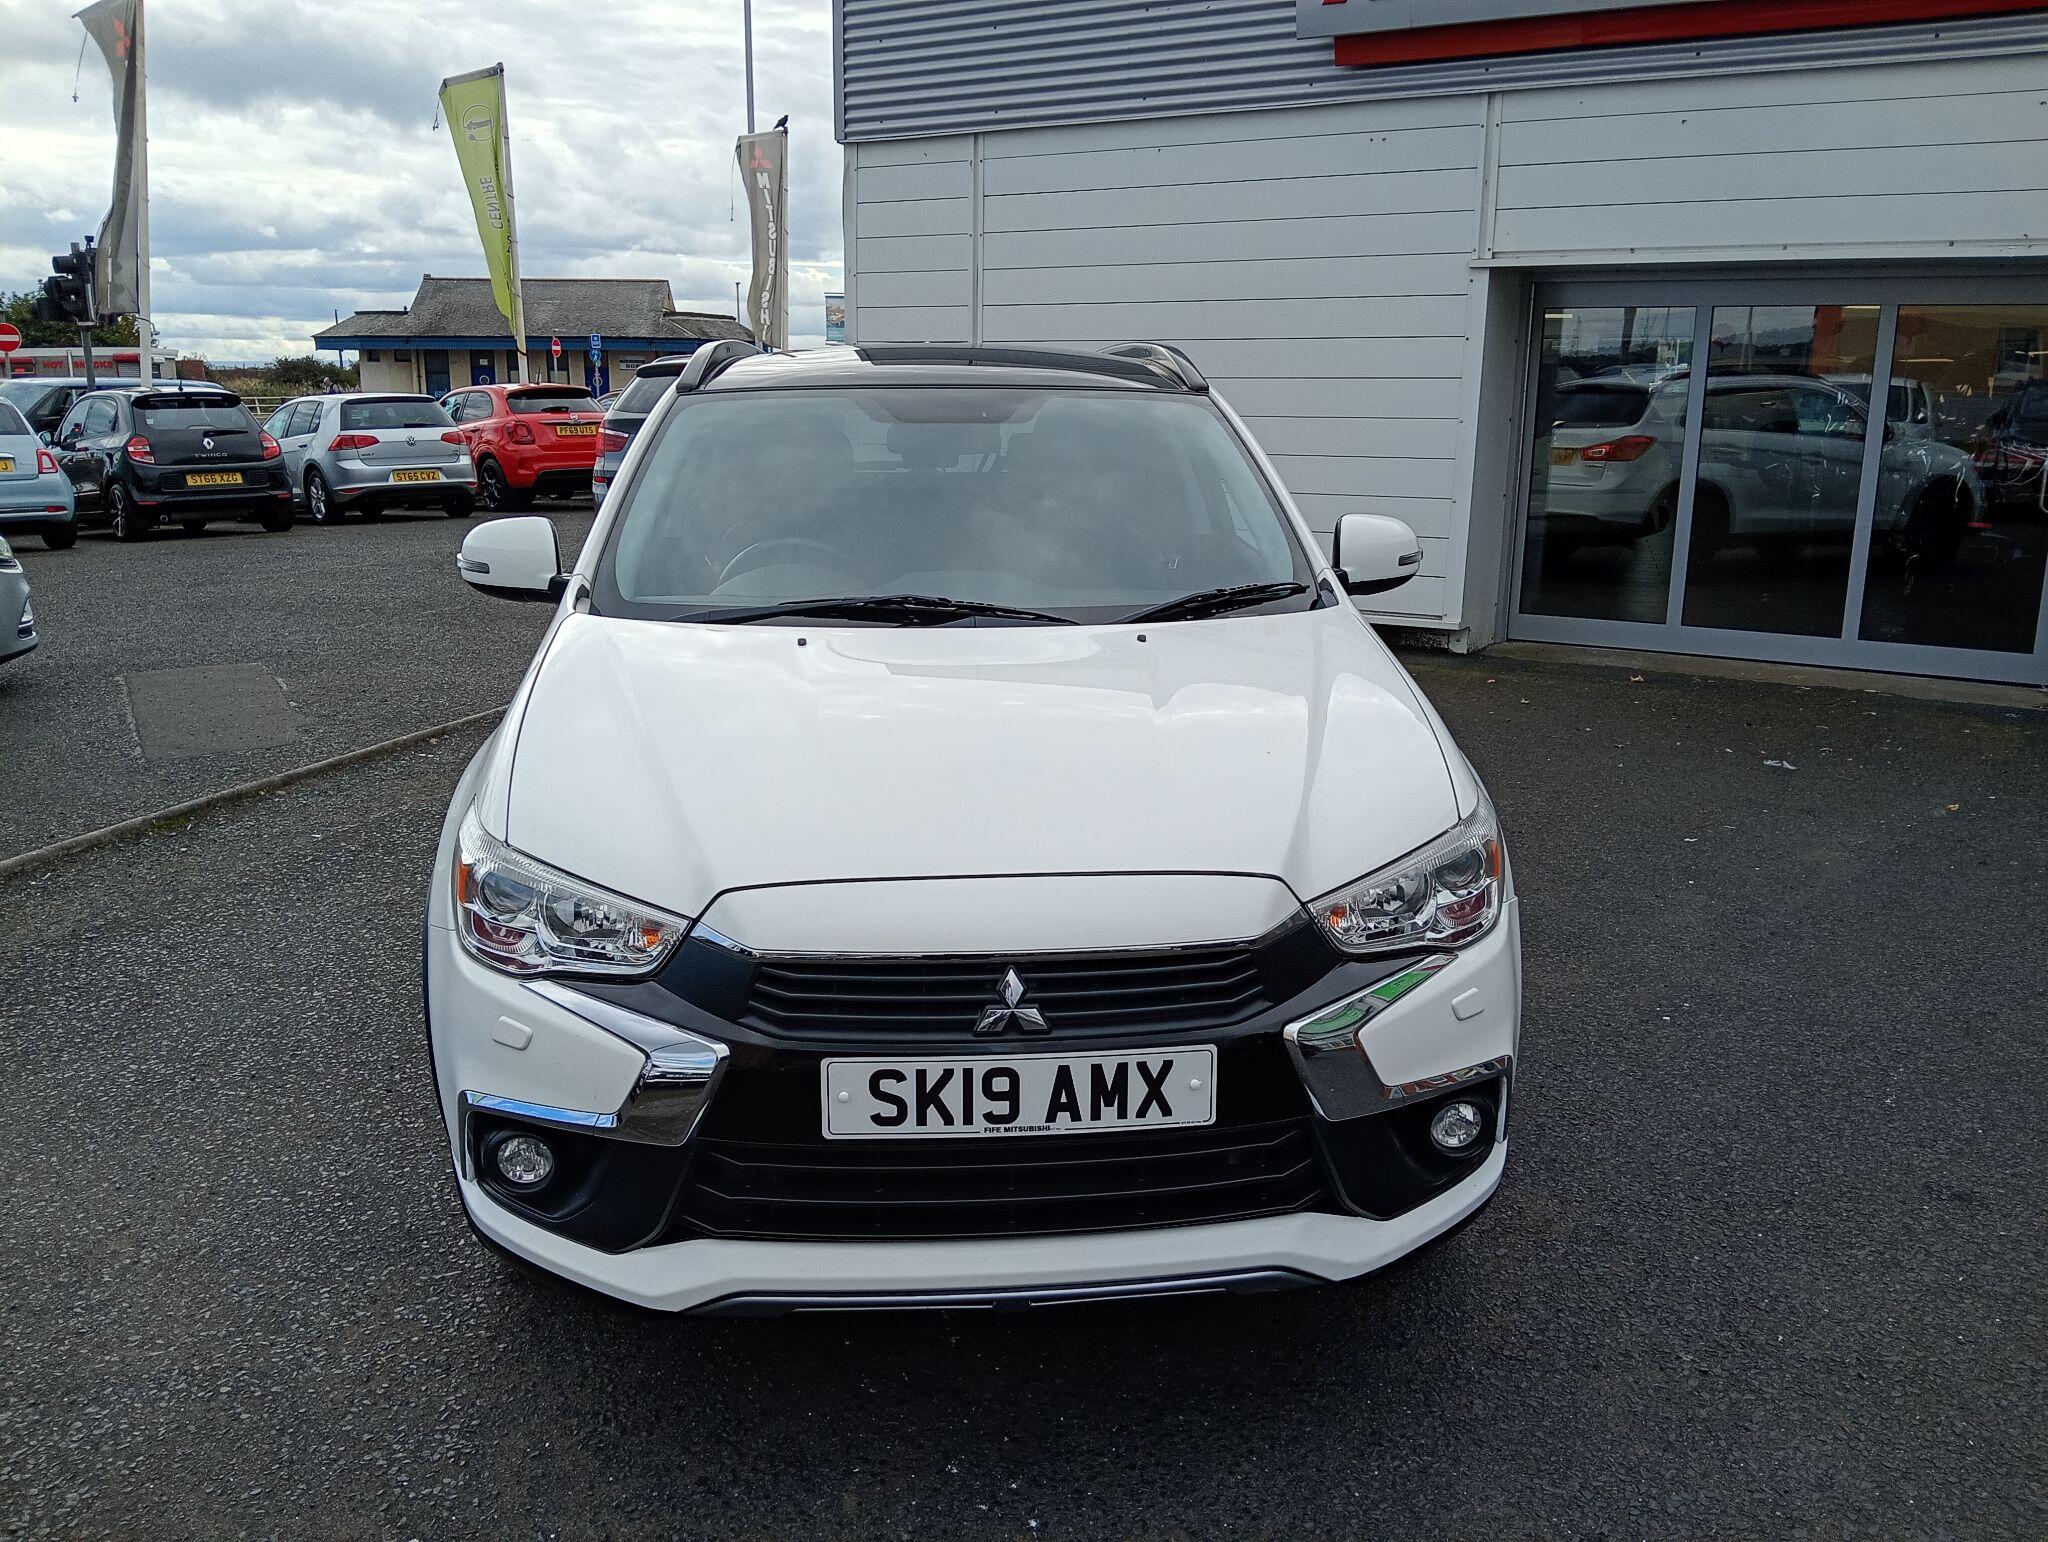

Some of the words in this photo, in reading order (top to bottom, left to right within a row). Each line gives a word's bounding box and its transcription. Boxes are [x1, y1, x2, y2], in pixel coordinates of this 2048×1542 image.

[73, 360, 113, 369] SNCKS
[191, 474, 217, 484] ST66
[219, 473, 238, 482] XZG
[397, 473, 418, 481] ST65
[420, 471, 436, 480] CVZ
[868, 1067, 1020, 1127] SK19
[1044, 1059, 1174, 1124] AMX
[984, 1126, 1002, 1134] FIFE
[1003, 1124, 1052, 1133] MITSUBISHI
